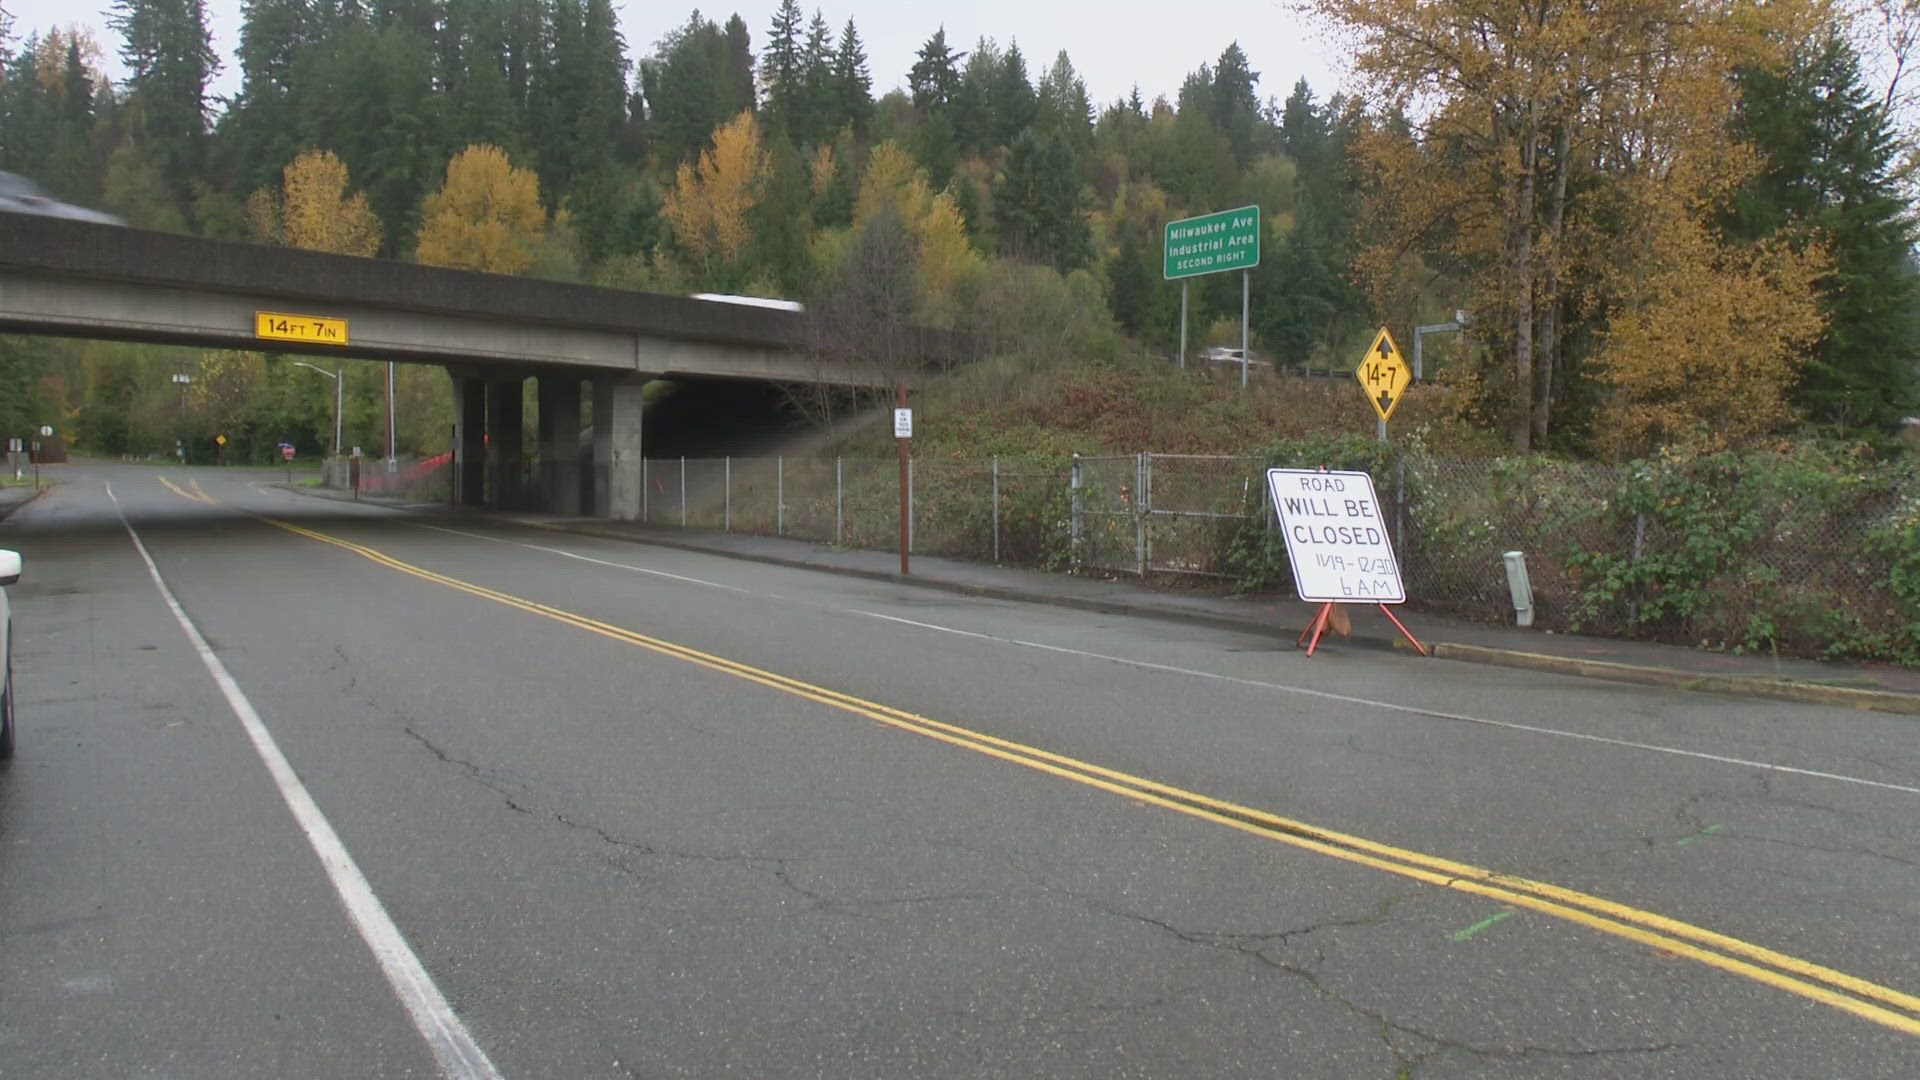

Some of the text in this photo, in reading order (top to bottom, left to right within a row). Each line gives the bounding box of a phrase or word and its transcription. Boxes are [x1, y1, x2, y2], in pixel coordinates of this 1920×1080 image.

[1170, 217, 1253, 240] Milwaukee Ave
[1169, 235, 1254, 257] Industrial Area
[1177, 251, 1245, 270] SECOND RIGHT
[1300, 478, 1345, 492] ROAD
[1284, 497, 1374, 517] WILL BE
[1294, 526, 1380, 545] CLOSED
